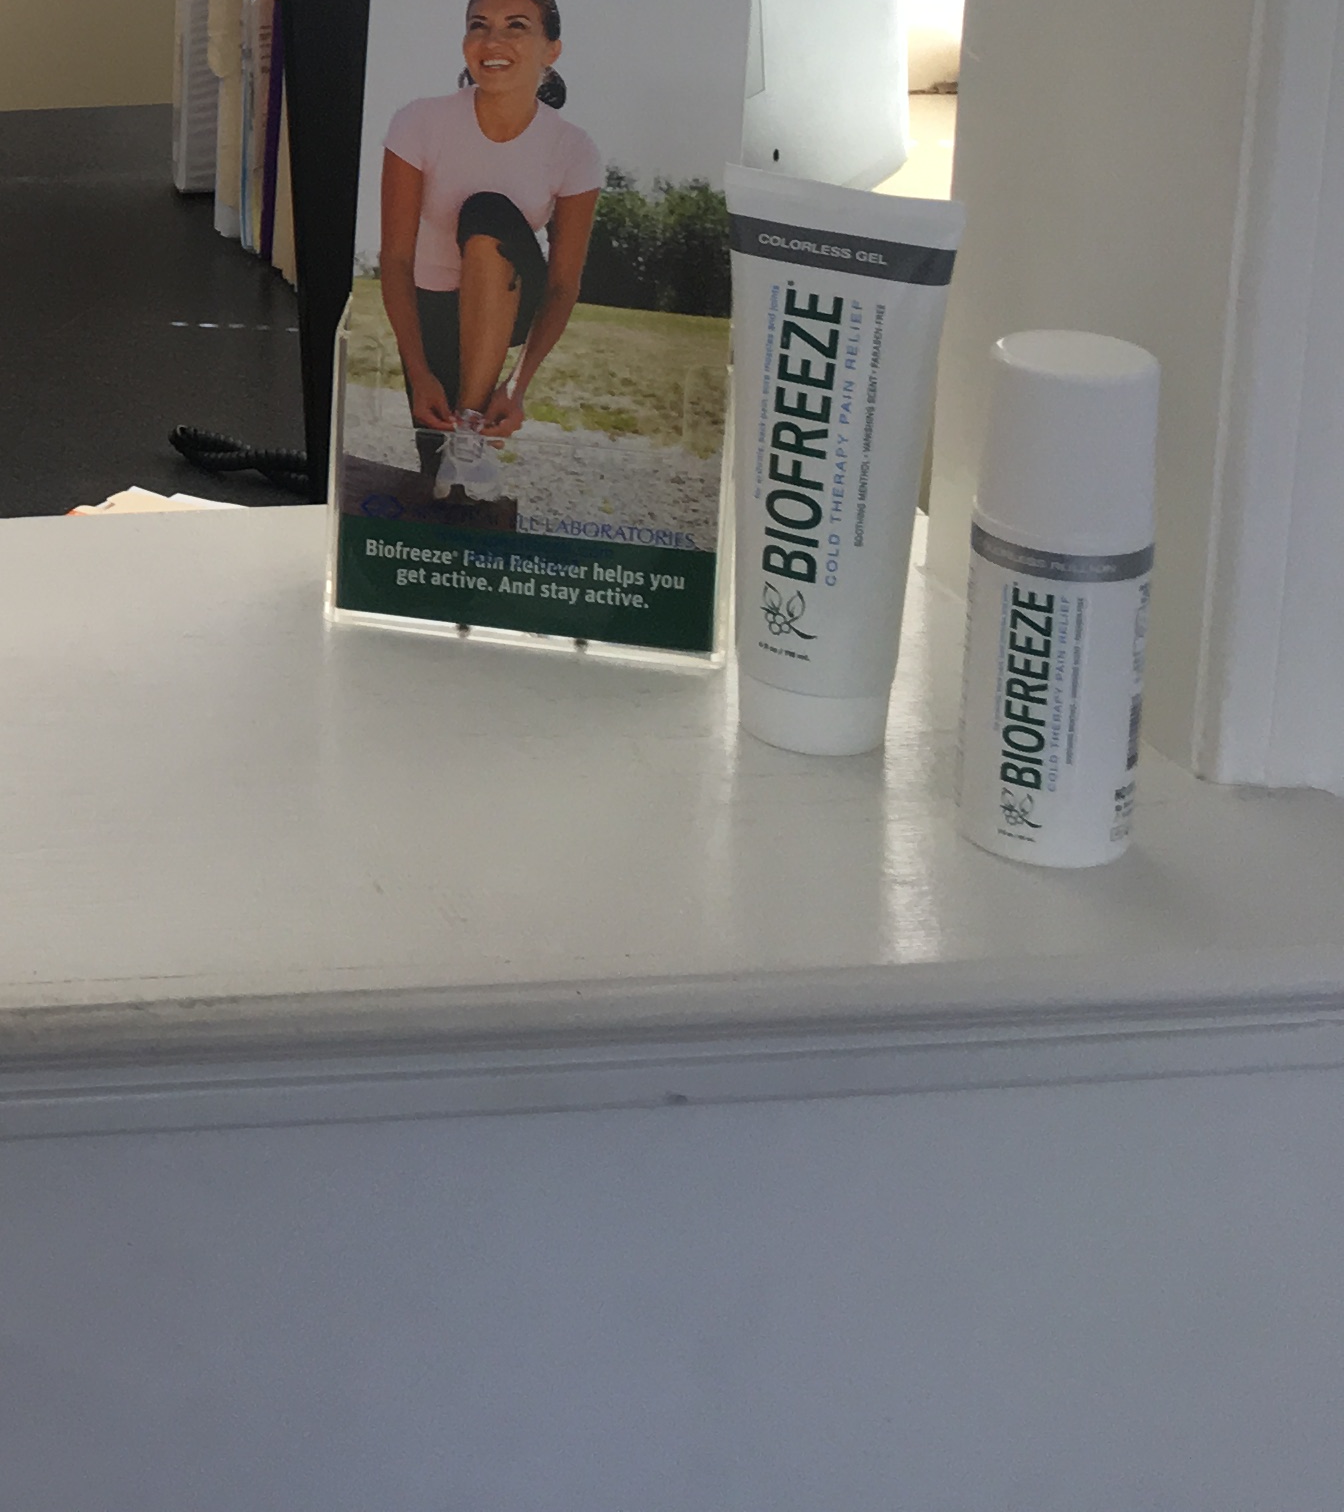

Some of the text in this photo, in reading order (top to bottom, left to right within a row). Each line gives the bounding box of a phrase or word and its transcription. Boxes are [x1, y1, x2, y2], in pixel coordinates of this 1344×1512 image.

[758, 233, 888, 266] COLORLESS GEL
[866, 376, 879, 404] SCENT
[763, 289, 843, 583] BIOFREEZE
[824, 300, 863, 587] COLD THERAPY PAIN RELIEF
[862, 406, 875, 452] VANISHING
[858, 461, 871, 501] MENTHOL
[396, 568, 650, 609] get active. And stay active.
[463, 549, 504, 570] Pain
[593, 562, 645, 587] helps
[650, 573, 685, 591] you
[1000, 587, 1054, 790] BIOFREEZE
[1047, 595, 1071, 792] COLD THERAPY PAIN RELIEF
